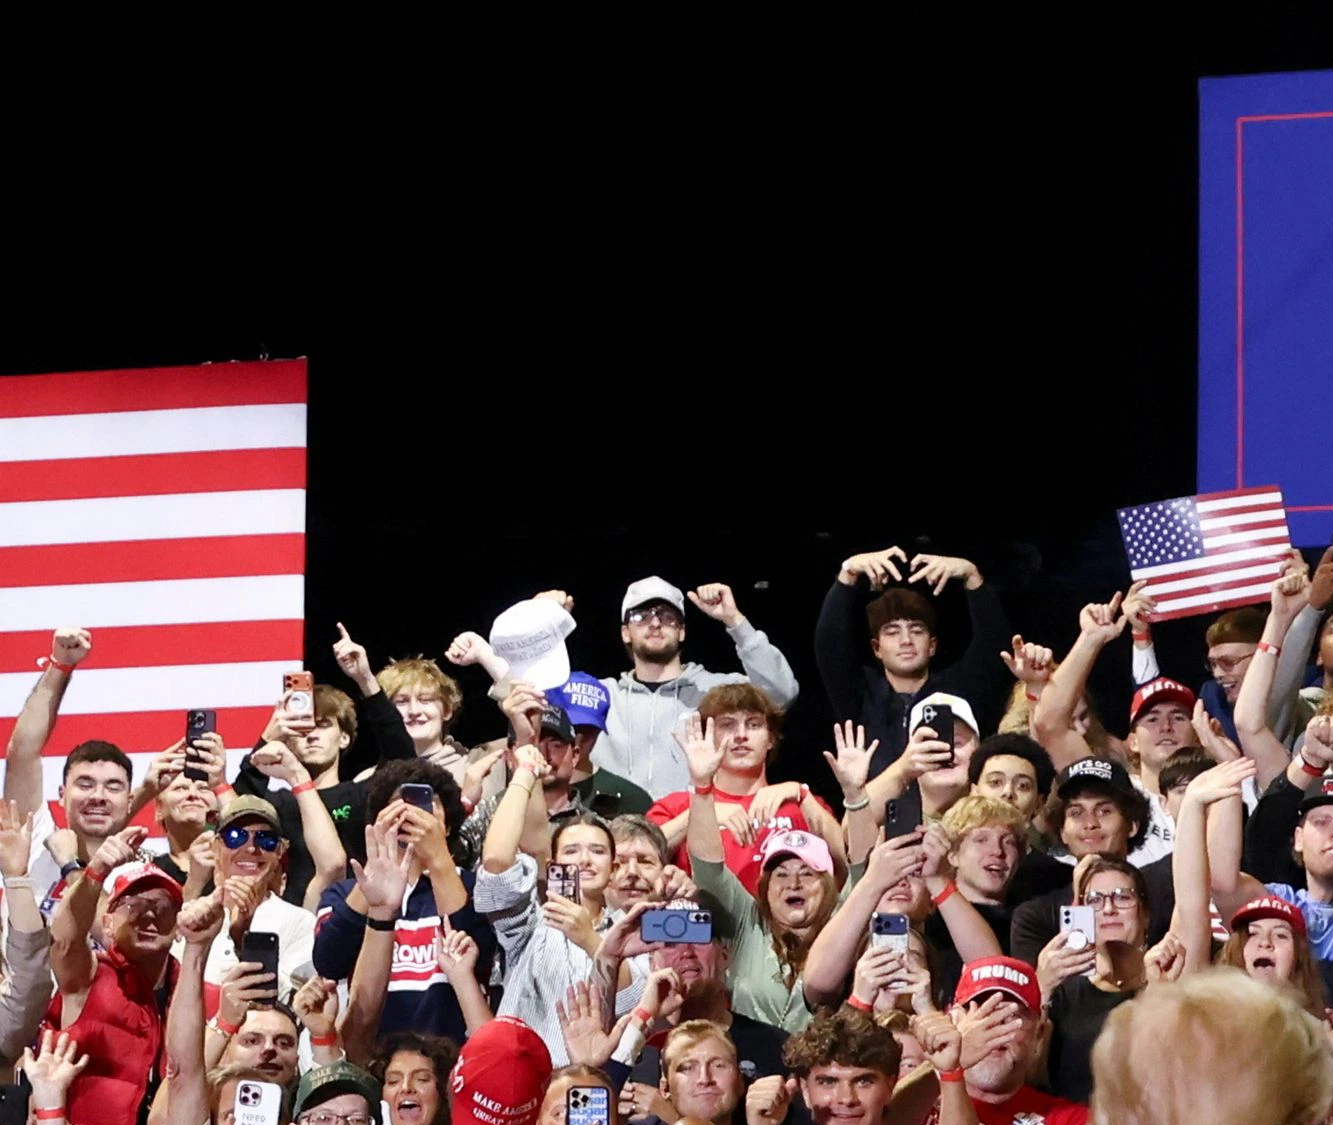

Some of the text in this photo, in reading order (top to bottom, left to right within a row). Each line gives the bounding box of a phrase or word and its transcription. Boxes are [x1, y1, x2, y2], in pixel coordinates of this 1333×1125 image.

[563, 681, 607, 702] AMERICA
[570, 693, 601, 710] FIRST
[1069, 760, 1112, 776] LET'S GO
[970, 964, 1030, 986] TRUMP
[472, 1090, 502, 1114] MAKE
